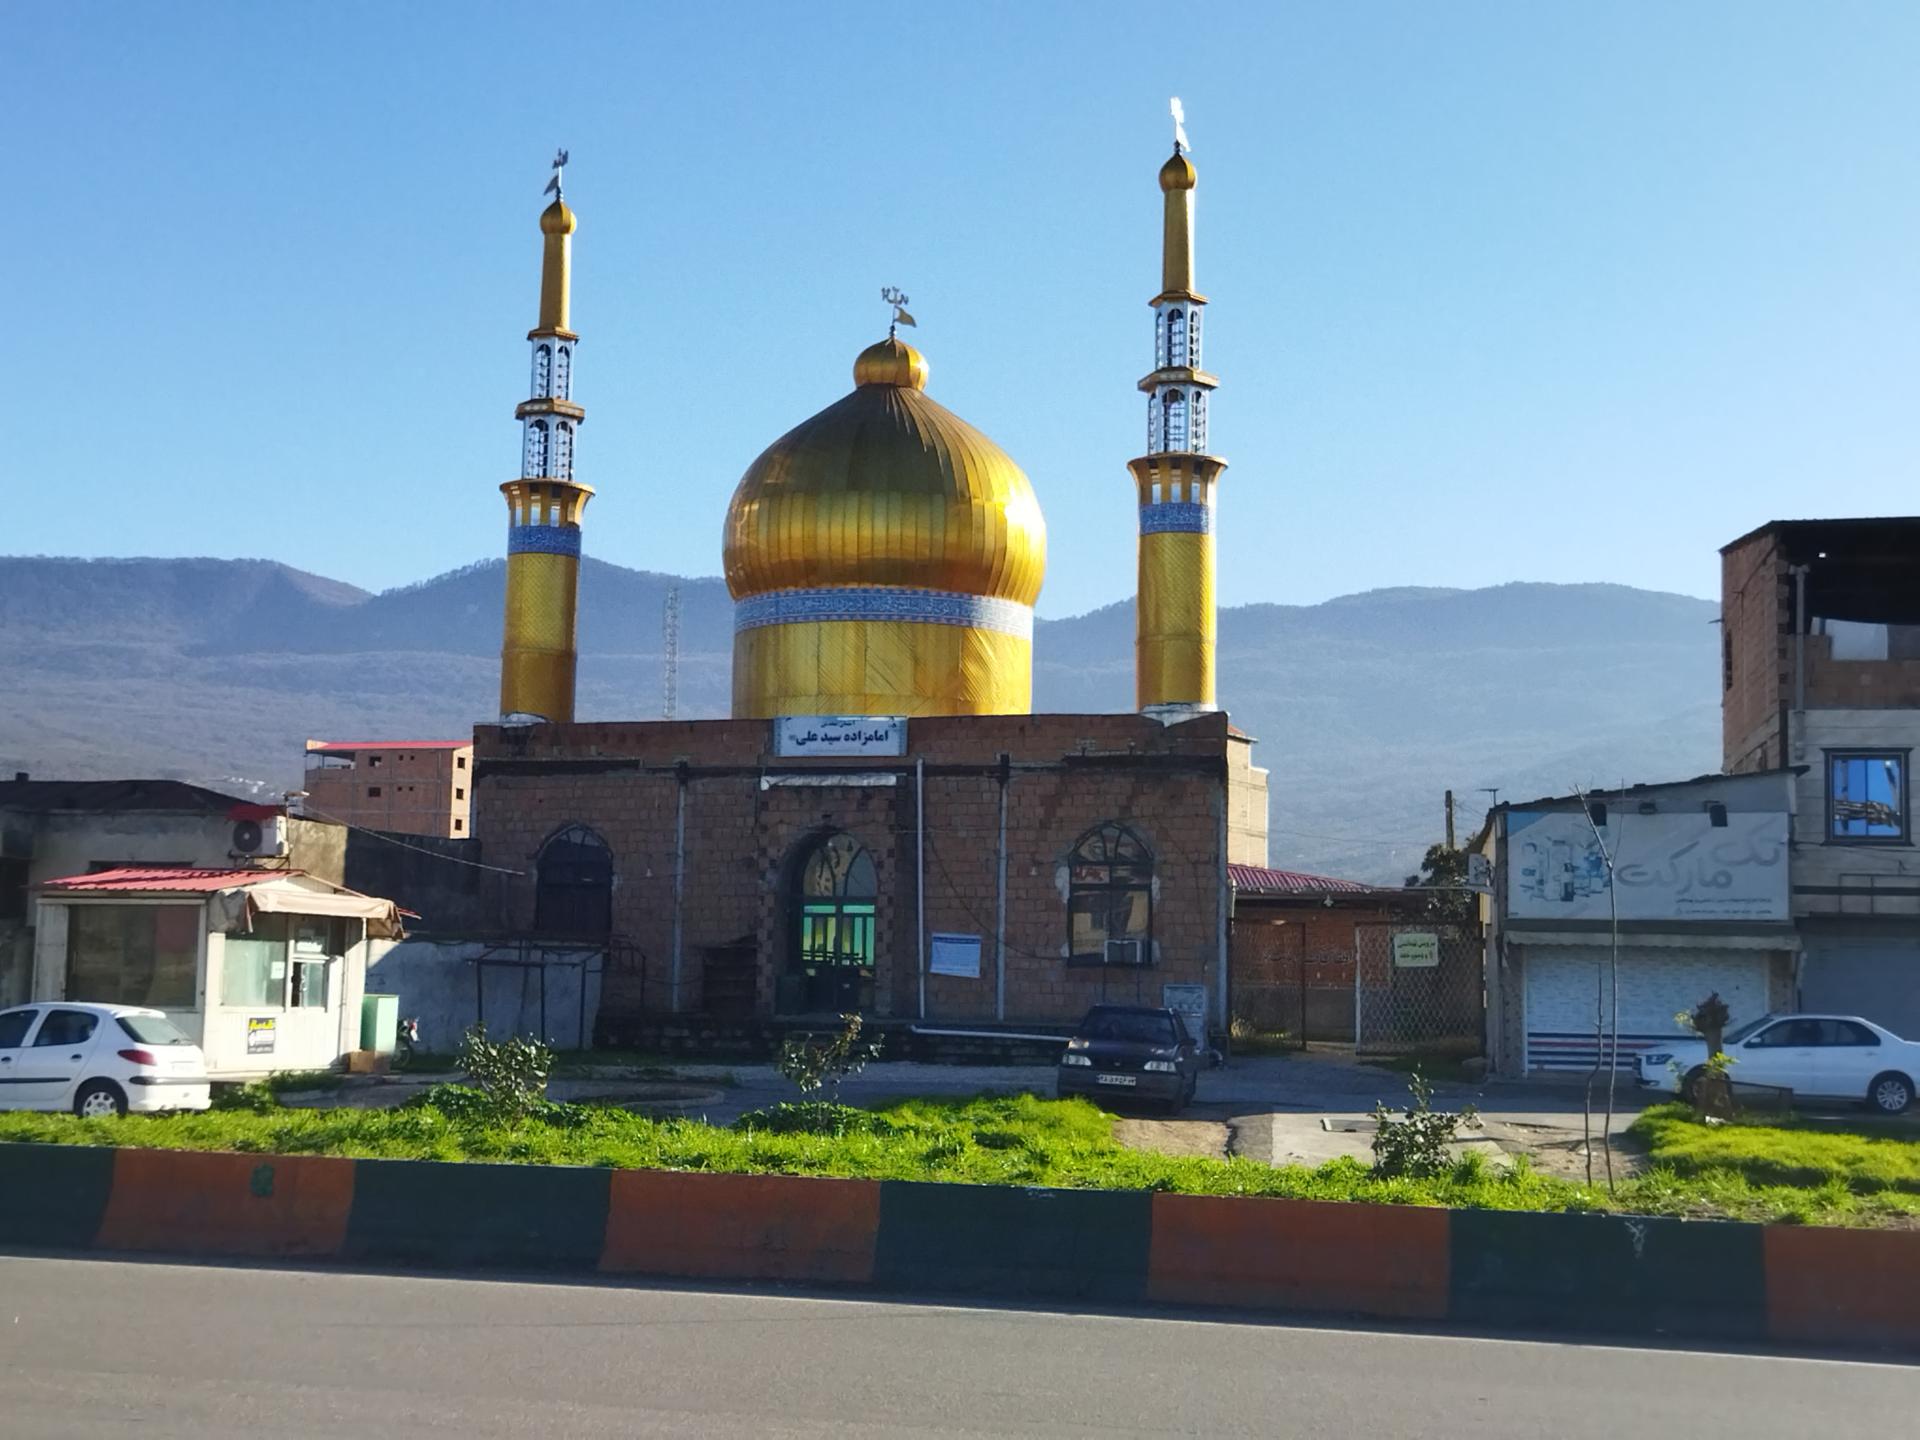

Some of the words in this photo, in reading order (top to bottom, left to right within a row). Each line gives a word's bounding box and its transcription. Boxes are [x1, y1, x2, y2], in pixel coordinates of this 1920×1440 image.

[820, 731, 841, 745] سید
[842, 729, 889, 746] امامزاده
[1615, 840, 1733, 896] مارکت
